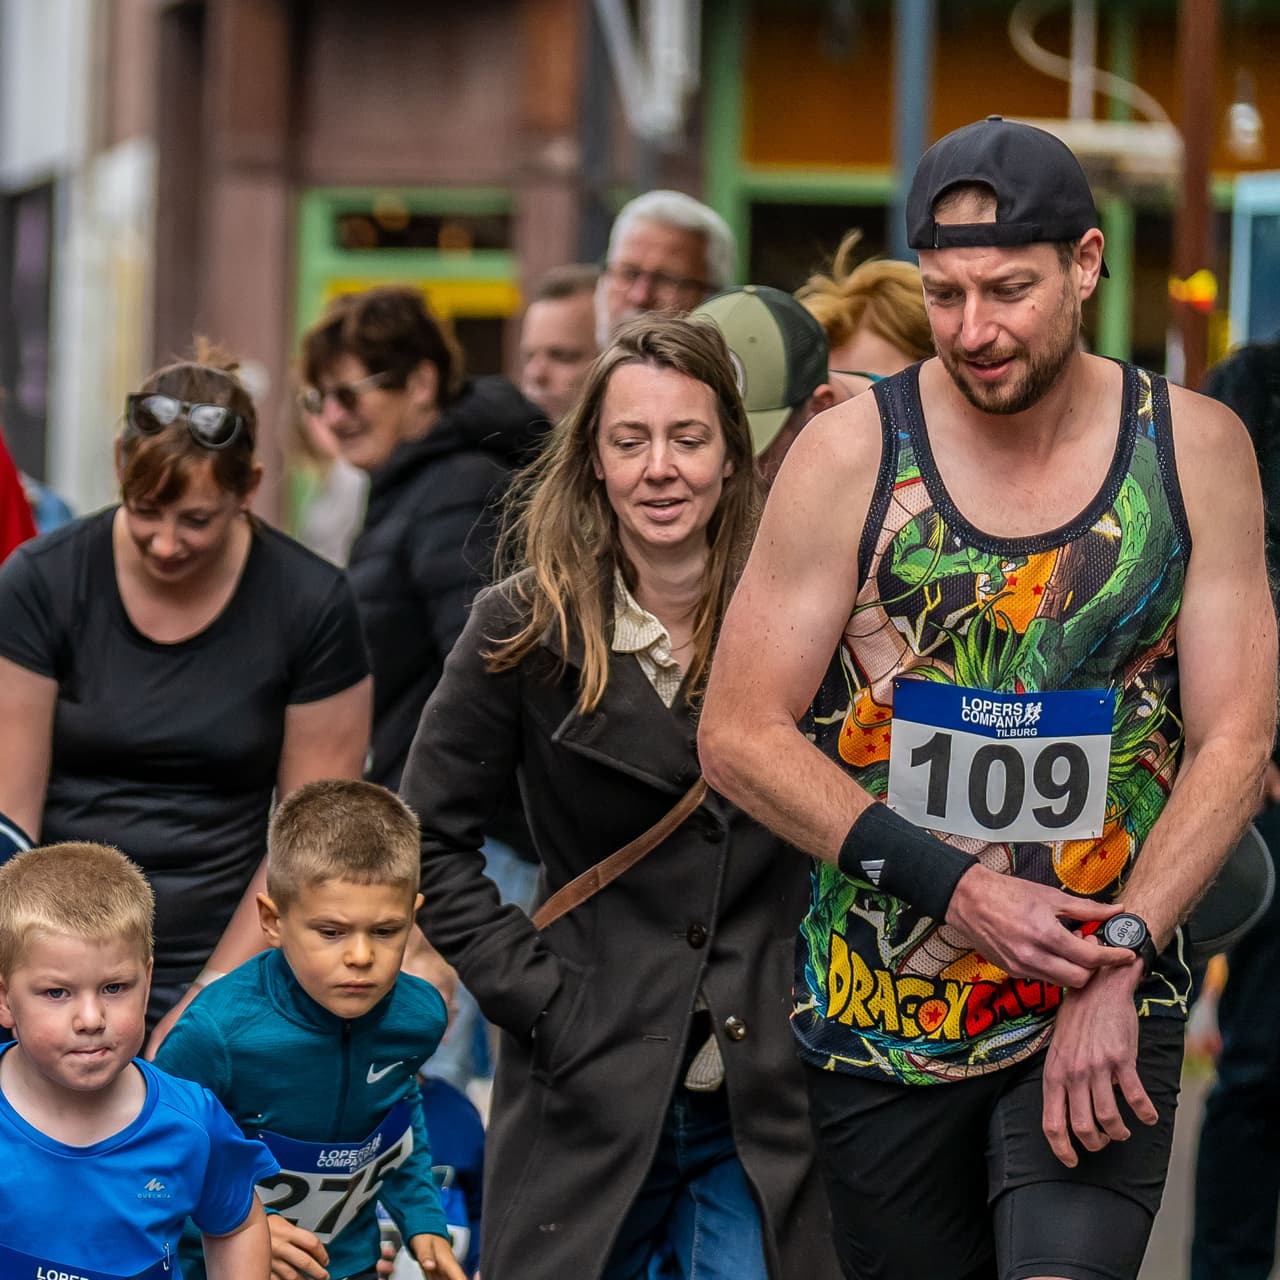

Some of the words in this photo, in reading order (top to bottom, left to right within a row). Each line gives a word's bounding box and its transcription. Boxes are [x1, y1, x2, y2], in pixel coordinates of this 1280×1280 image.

[961, 696, 1023, 717] LOPERS
[961, 708, 1022, 729] COMPANY
[995, 728, 1038, 738] TILBURG
[910, 731, 1090, 830] 109
[826, 932, 973, 1041] DRAGON
